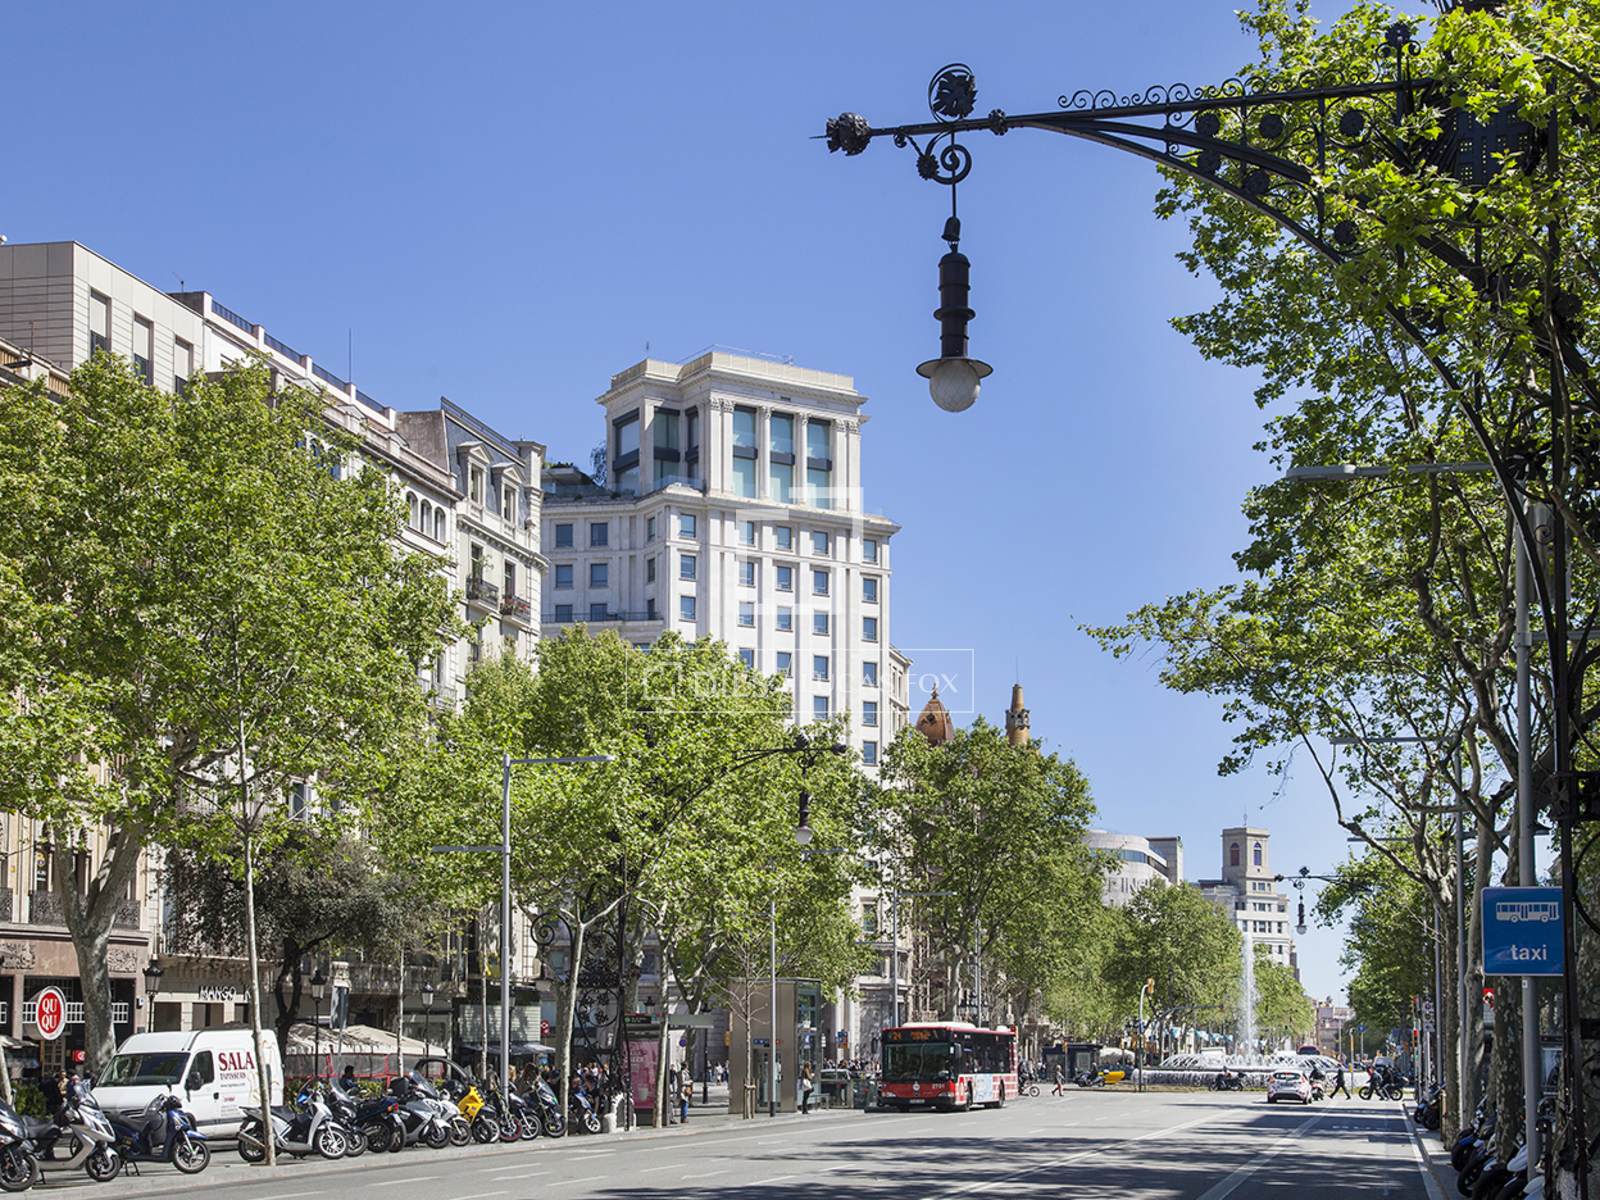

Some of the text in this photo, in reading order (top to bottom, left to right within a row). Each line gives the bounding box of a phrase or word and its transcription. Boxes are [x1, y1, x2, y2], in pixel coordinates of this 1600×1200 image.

[1511, 944, 1547, 960] taxi
[199, 985, 236, 1001] MANGO
[42, 998, 57, 1014] QU
[42, 1014, 57, 1031] QU
[218, 1051, 255, 1071] SALA
